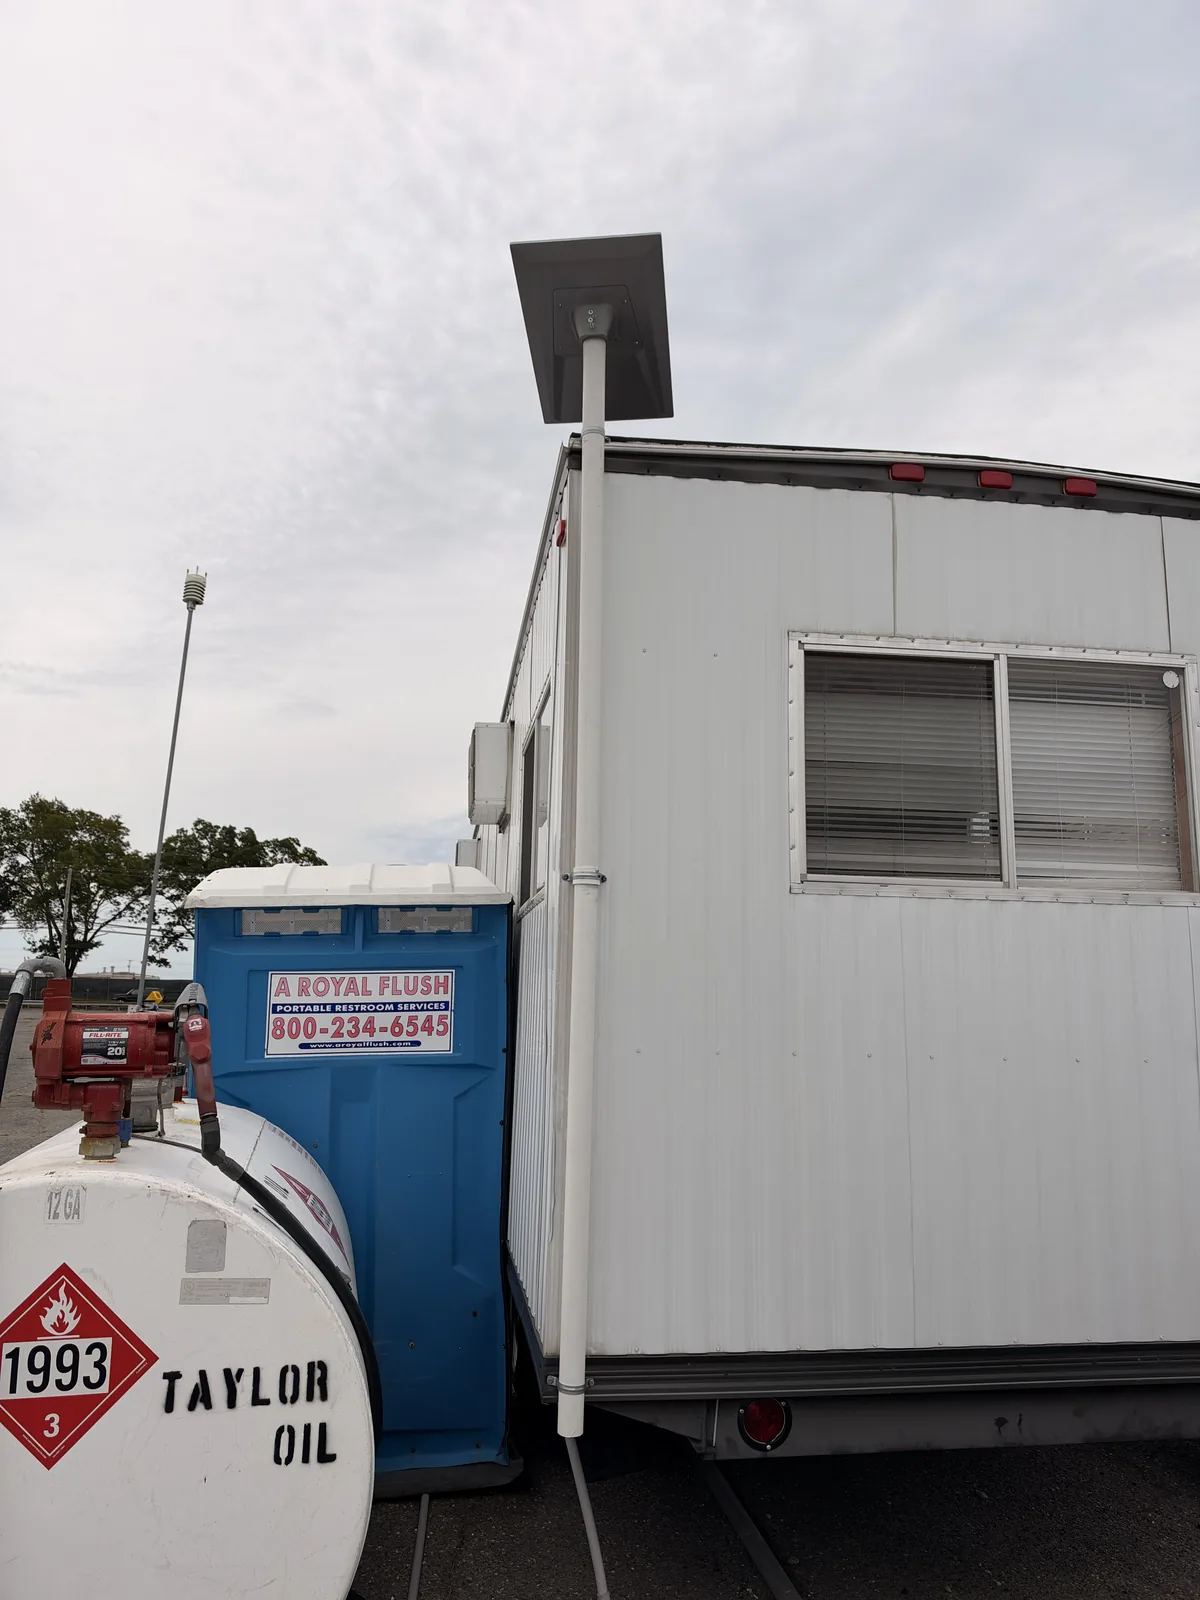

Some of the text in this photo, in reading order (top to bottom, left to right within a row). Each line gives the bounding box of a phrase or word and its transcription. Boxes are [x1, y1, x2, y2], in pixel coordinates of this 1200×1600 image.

[274, 975, 449, 997] A ROYAL FLUSH
[276, 1002, 446, 1013] PORTABLE RESTROOM SERVICES
[271, 1014, 449, 1040] 800-234-6545
[107, 1047, 121, 1055] 20
[309, 1040, 412, 1048] www.aroyalflush.com
[47, 1188, 81, 1221] 12 GA
[5, 1341, 108, 1394] 1993
[162, 1360, 329, 1414] TAYLOR
[43, 1413, 61, 1438] 3
[273, 1422, 338, 1467] OIL
